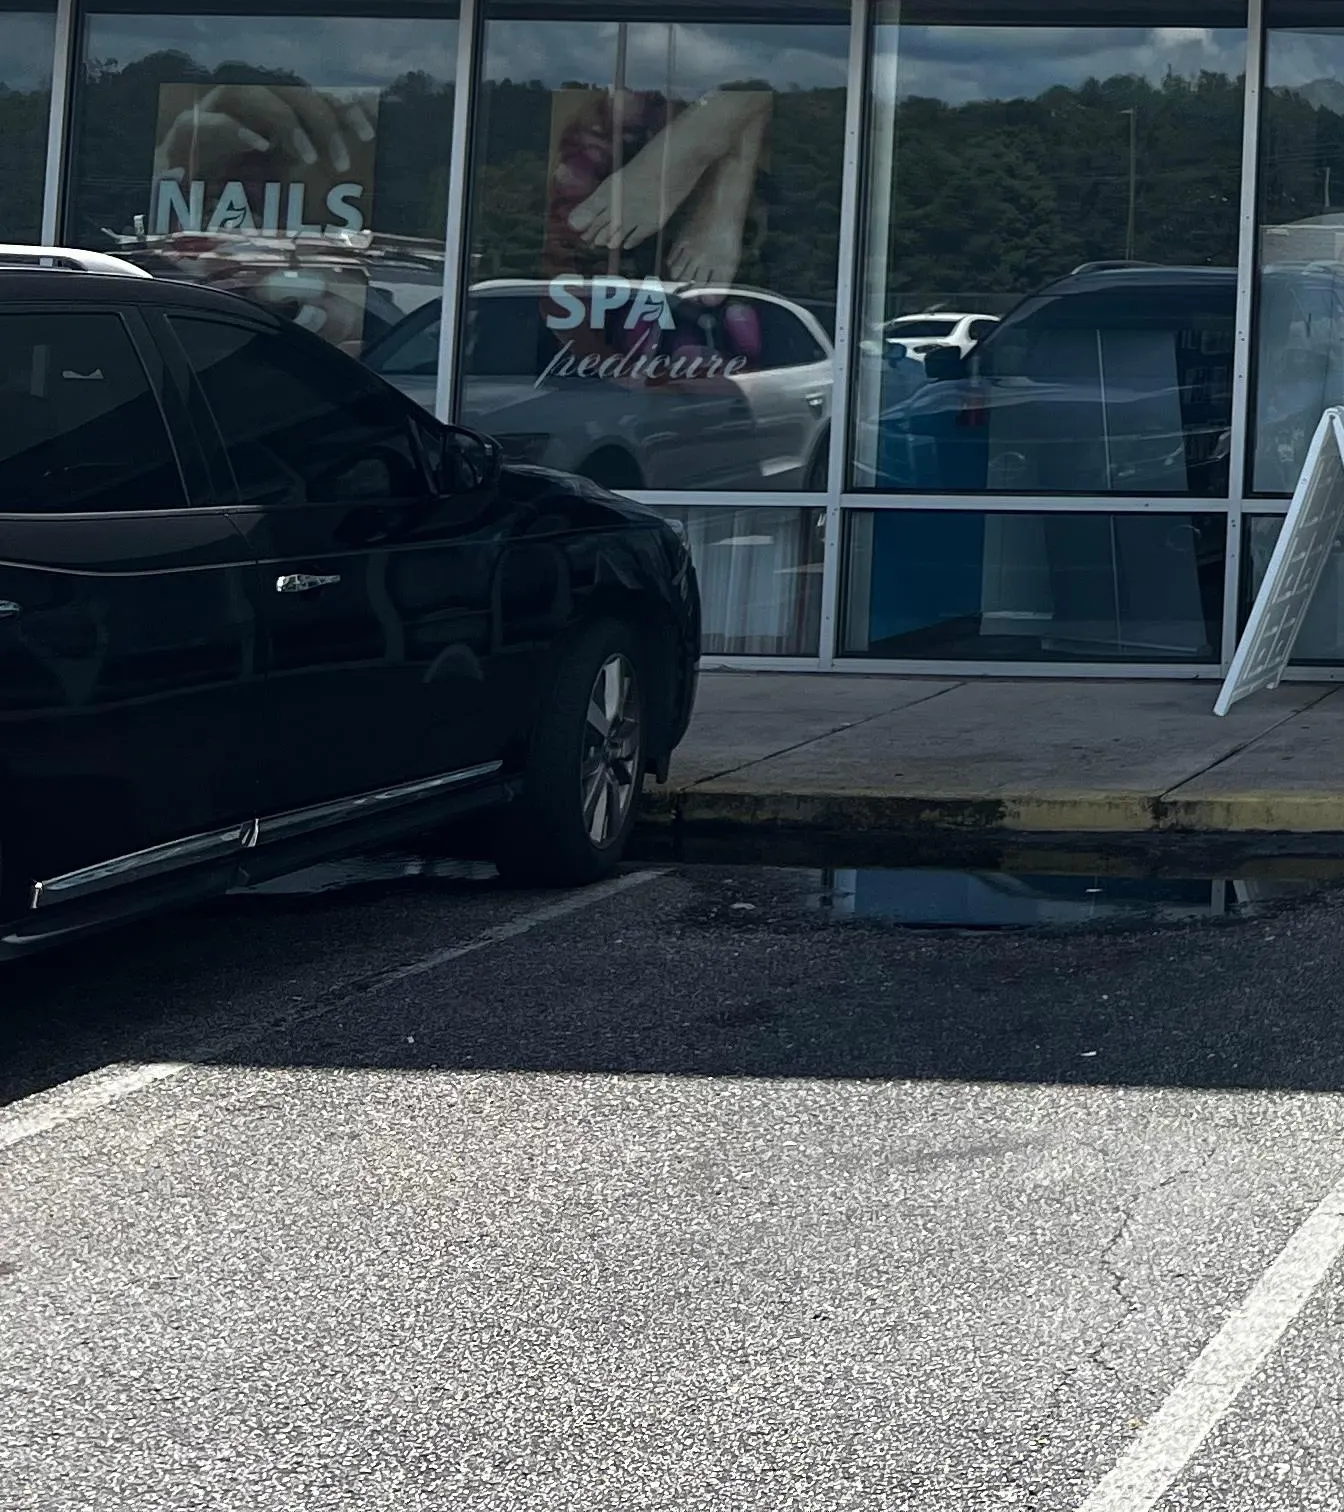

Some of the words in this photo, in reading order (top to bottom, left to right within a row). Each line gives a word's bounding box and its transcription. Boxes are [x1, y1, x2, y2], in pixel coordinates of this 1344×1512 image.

[156, 180, 364, 238] NAILS
[546, 274, 677, 330] SPA
[533, 329, 748, 389] pedicure
